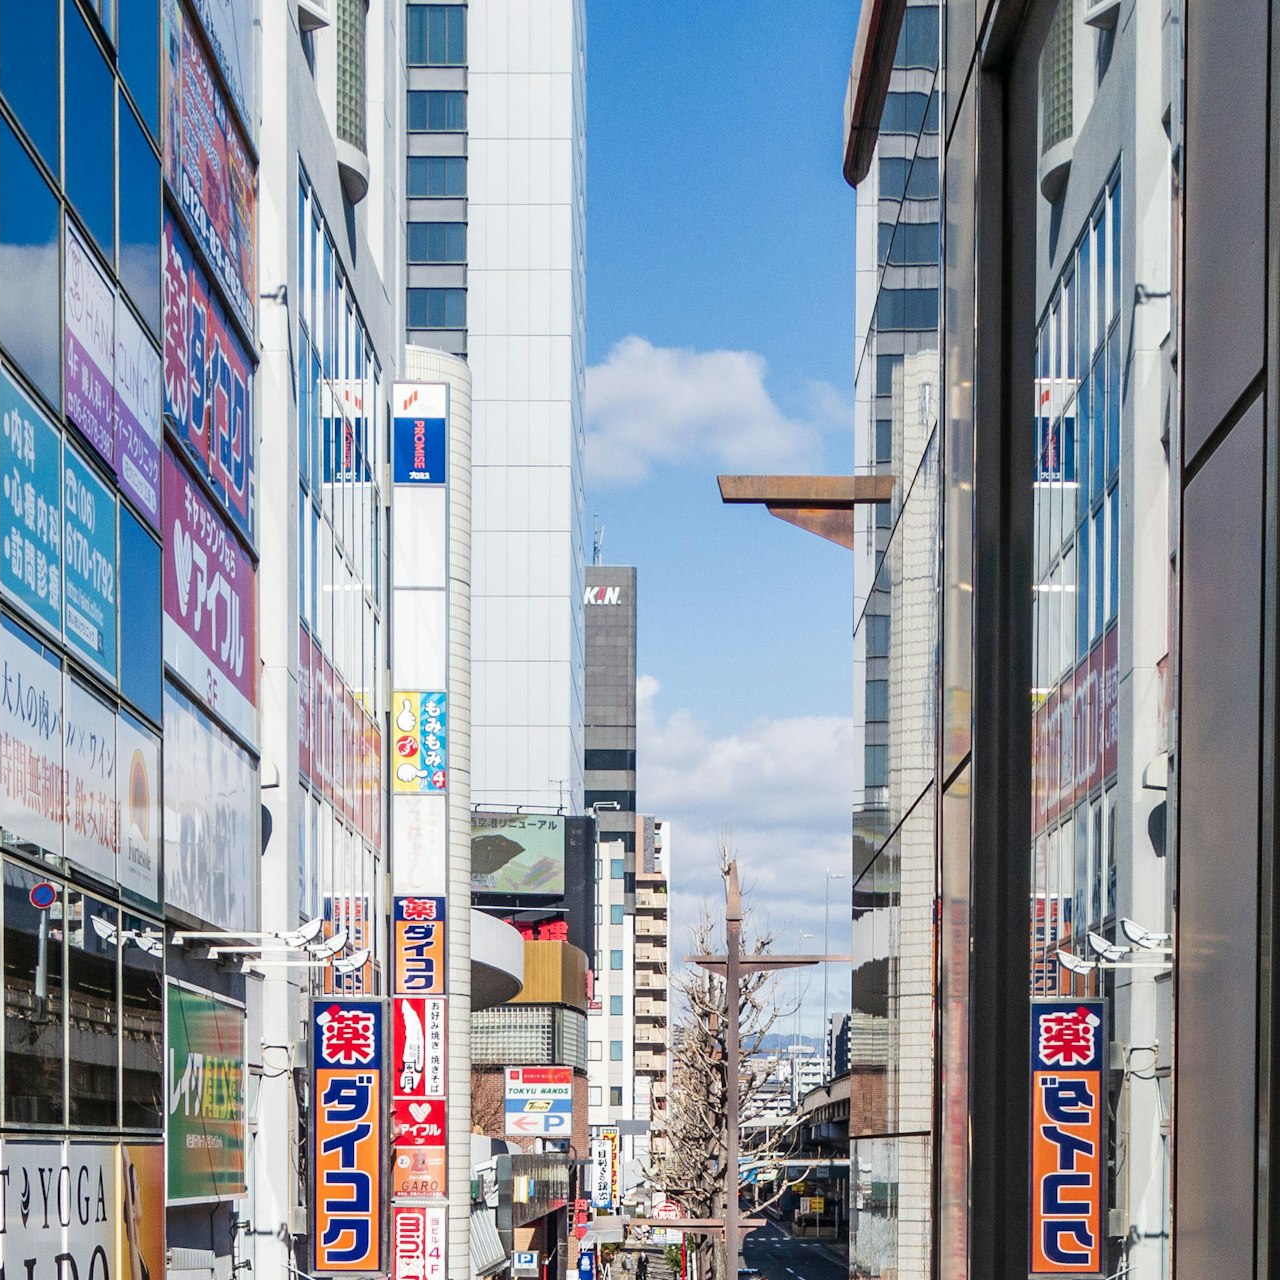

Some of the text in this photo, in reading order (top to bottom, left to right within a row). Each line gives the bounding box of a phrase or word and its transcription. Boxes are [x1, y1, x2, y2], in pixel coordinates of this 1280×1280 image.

[67, 342, 79, 381] 4F
[85, 302, 149, 407] HANA CLINIC
[10, 408, 34, 471] 内科
[414, 420, 425, 469] PROMISE
[409, 471, 430, 480] プロミス
[10, 473, 60, 558] 心療内科
[185, 483, 236, 579] キャッシングなら
[10, 531, 60, 609] 訪問診療
[66, 519, 113, 602] 6170-1792
[192, 540, 244, 678] アイフル
[206, 668, 218, 709] 3F
[424, 699, 441, 768] もみもみ
[0, 730, 121, 855] 時間無制限 飲み放題
[404, 899, 436, 919] 薬
[403, 924, 435, 990] ダイコク
[322, 1010, 375, 1064] 薬
[508, 1087, 570, 1095] TOKYU HANDS
[401, 1124, 441, 1137] アイフル
[544, 1116, 564, 1131] P
[38, 1164, 107, 1229] YOGA
[322, 1075, 373, 1264] ダイコク
[402, 1181, 439, 1191] GARO
[519, 1254, 532, 1263] P
